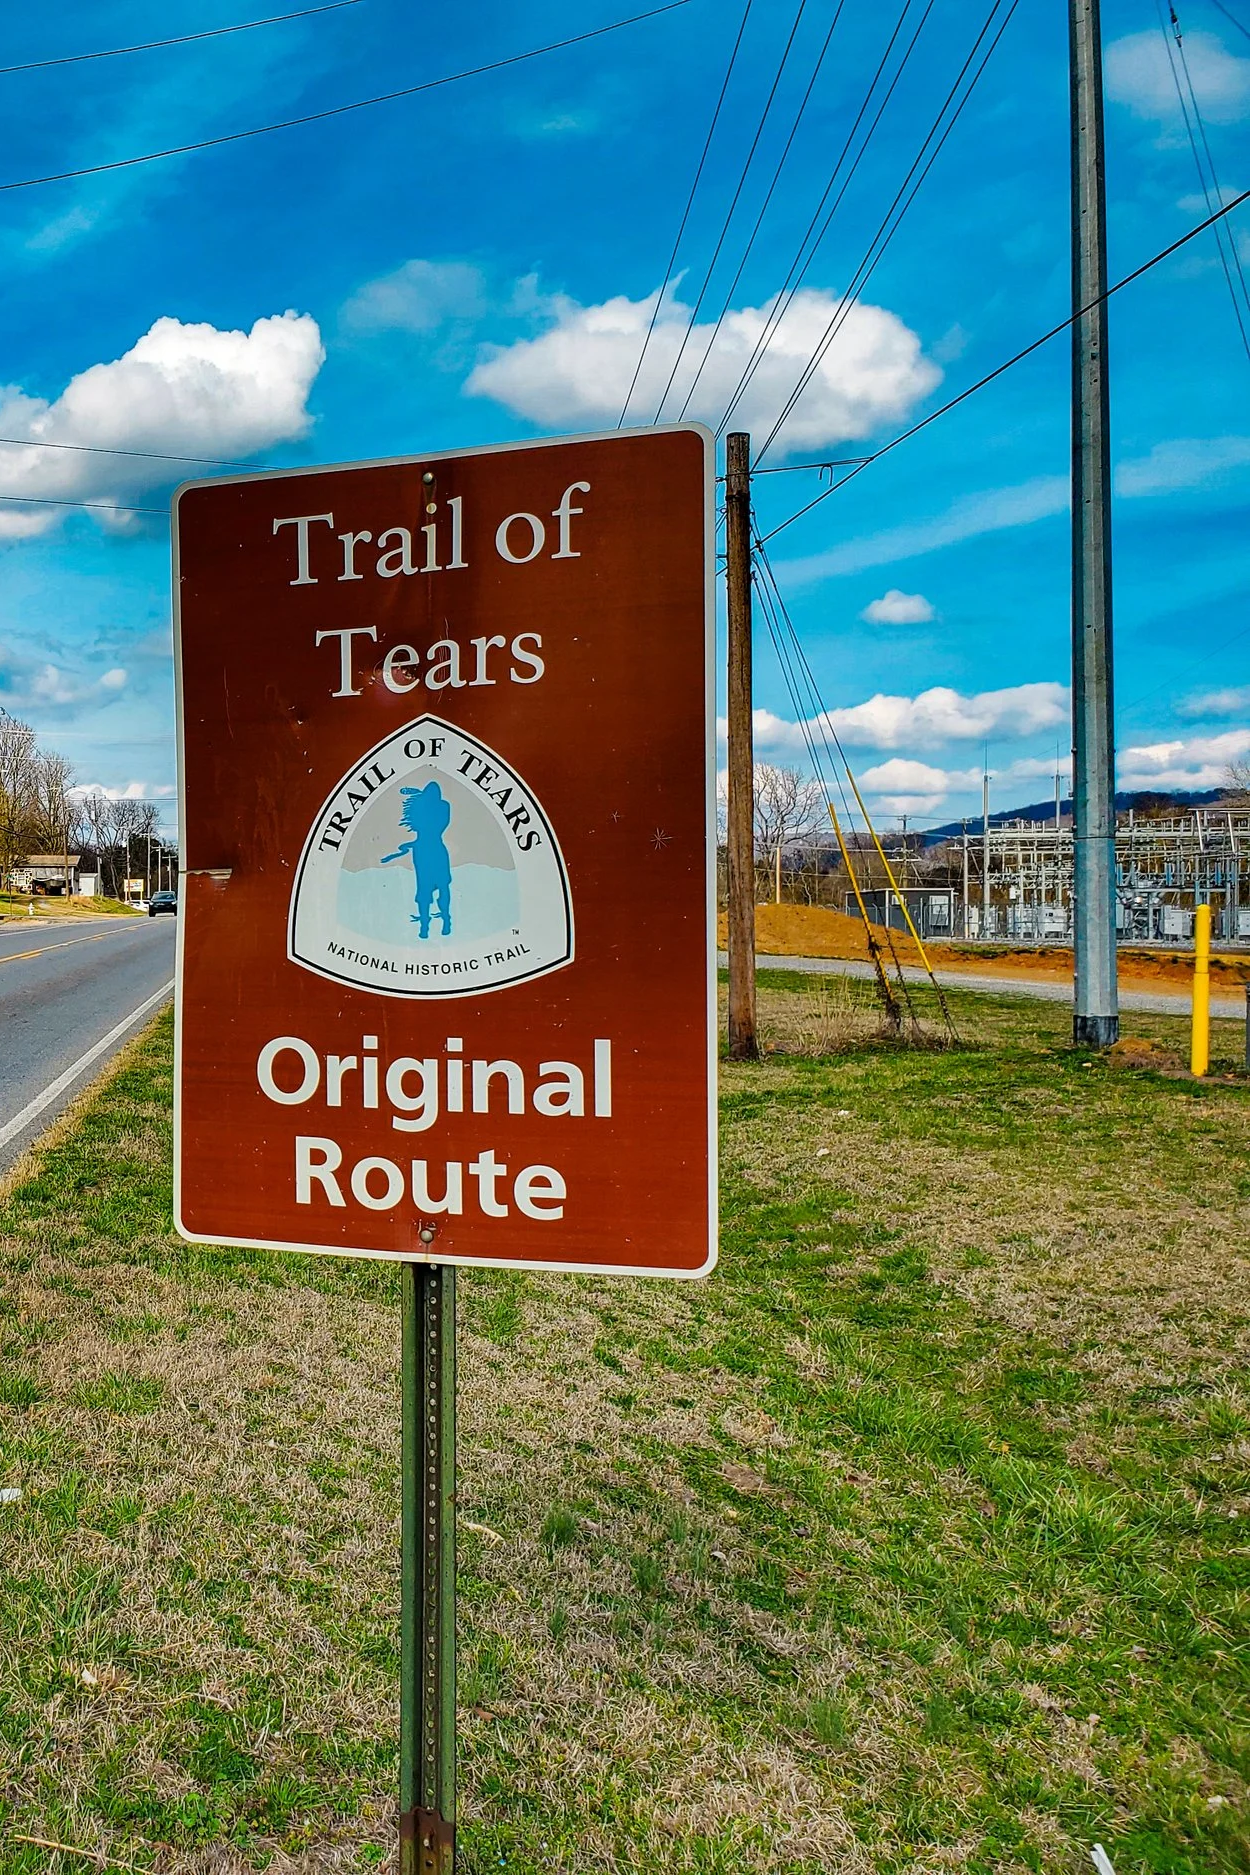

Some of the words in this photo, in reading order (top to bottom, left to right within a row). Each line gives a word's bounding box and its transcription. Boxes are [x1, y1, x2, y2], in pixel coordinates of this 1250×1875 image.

[272, 495, 469, 586] Trail
[495, 481, 591, 564] of
[315, 625, 546, 698] Tears
[318, 761, 396, 852] TRAIL
[403, 737, 446, 759] OF
[456, 749, 542, 852] TEARS
[327, 941, 399, 973] NATIONAL
[404, 959, 479, 975] HISTORIC
[484, 943, 531, 967] TRAIL
[256, 1034, 612, 1133] Original
[295, 1135, 567, 1220] Route
